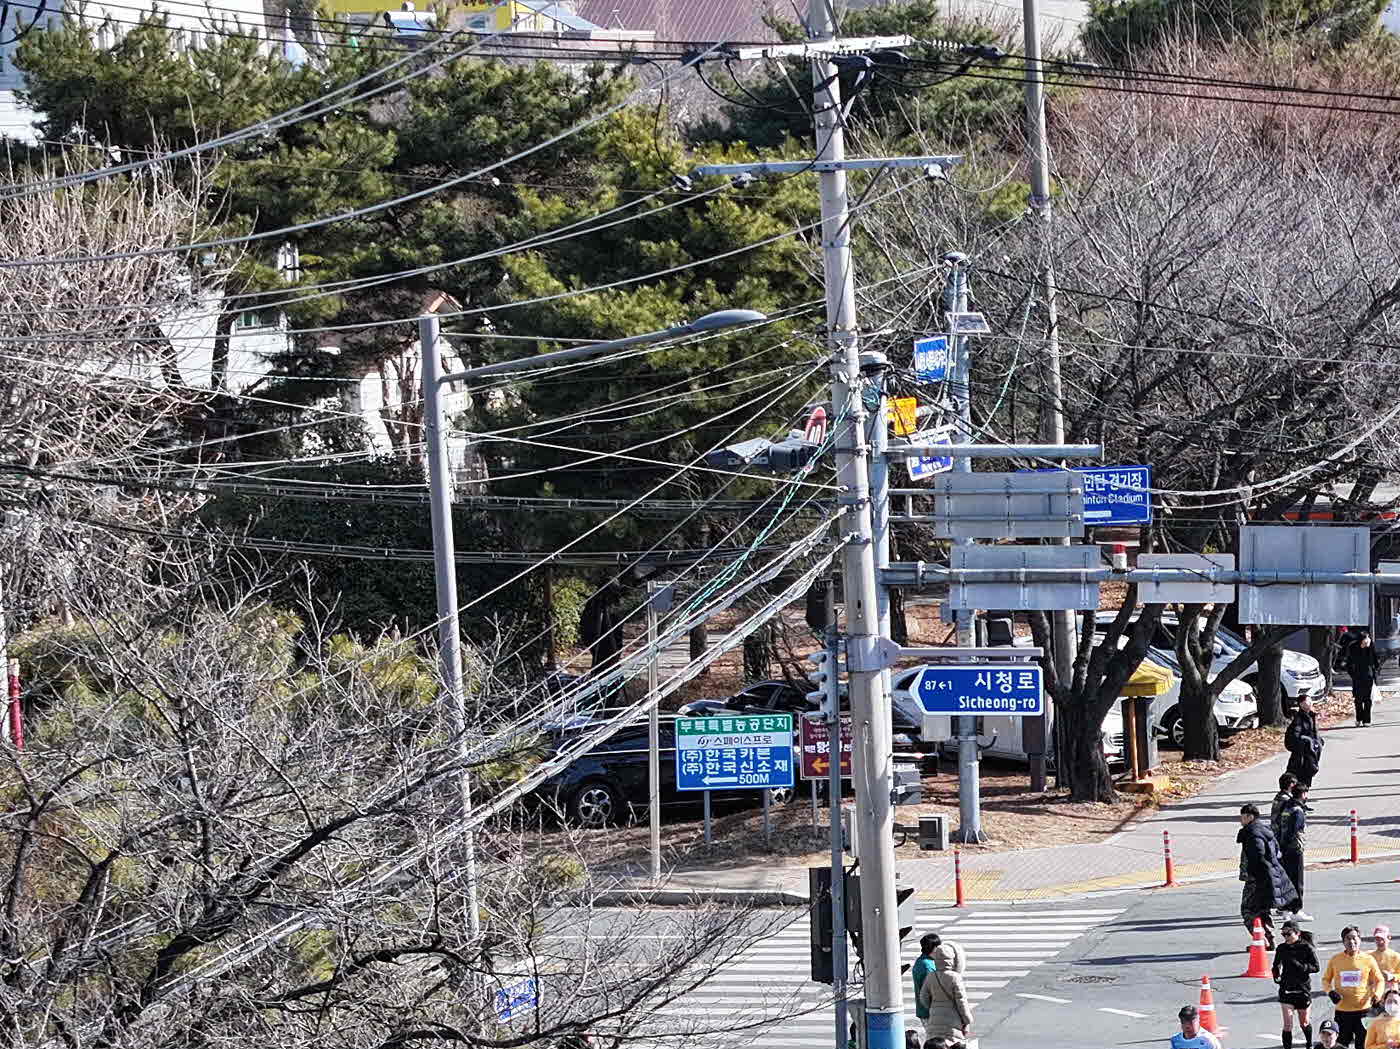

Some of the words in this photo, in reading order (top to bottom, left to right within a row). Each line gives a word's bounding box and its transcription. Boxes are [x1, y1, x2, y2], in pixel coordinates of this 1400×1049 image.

[1109, 471, 1142, 491] 경기장
[975, 671, 1036, 694] 시청로
[959, 695, 1036, 711] Sicheong-ro
[739, 774, 770, 785] 500M
